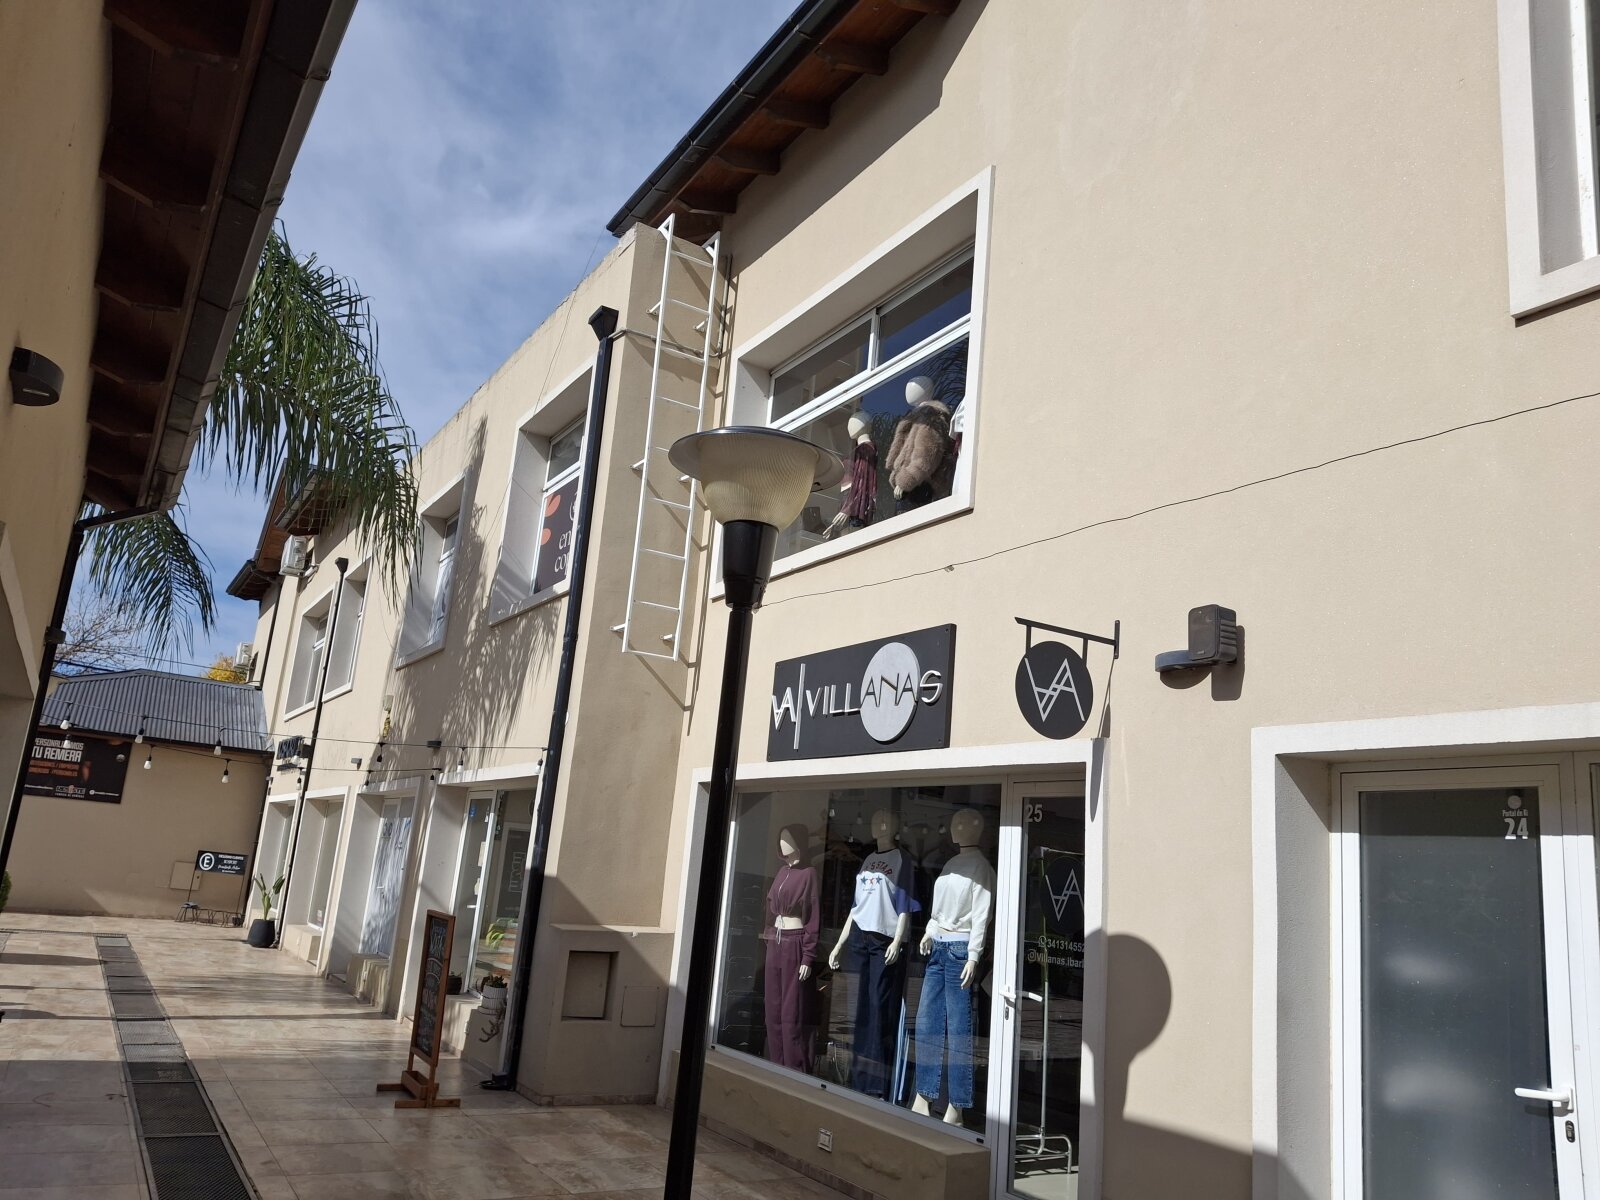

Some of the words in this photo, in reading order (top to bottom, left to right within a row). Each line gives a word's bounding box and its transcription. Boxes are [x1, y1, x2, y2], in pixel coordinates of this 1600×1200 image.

[805, 669, 944, 717] VILLANAS
[44, 747, 83, 763] REMERA
[1024, 803, 1043, 823] 25
[1503, 817, 1529, 840] 24
